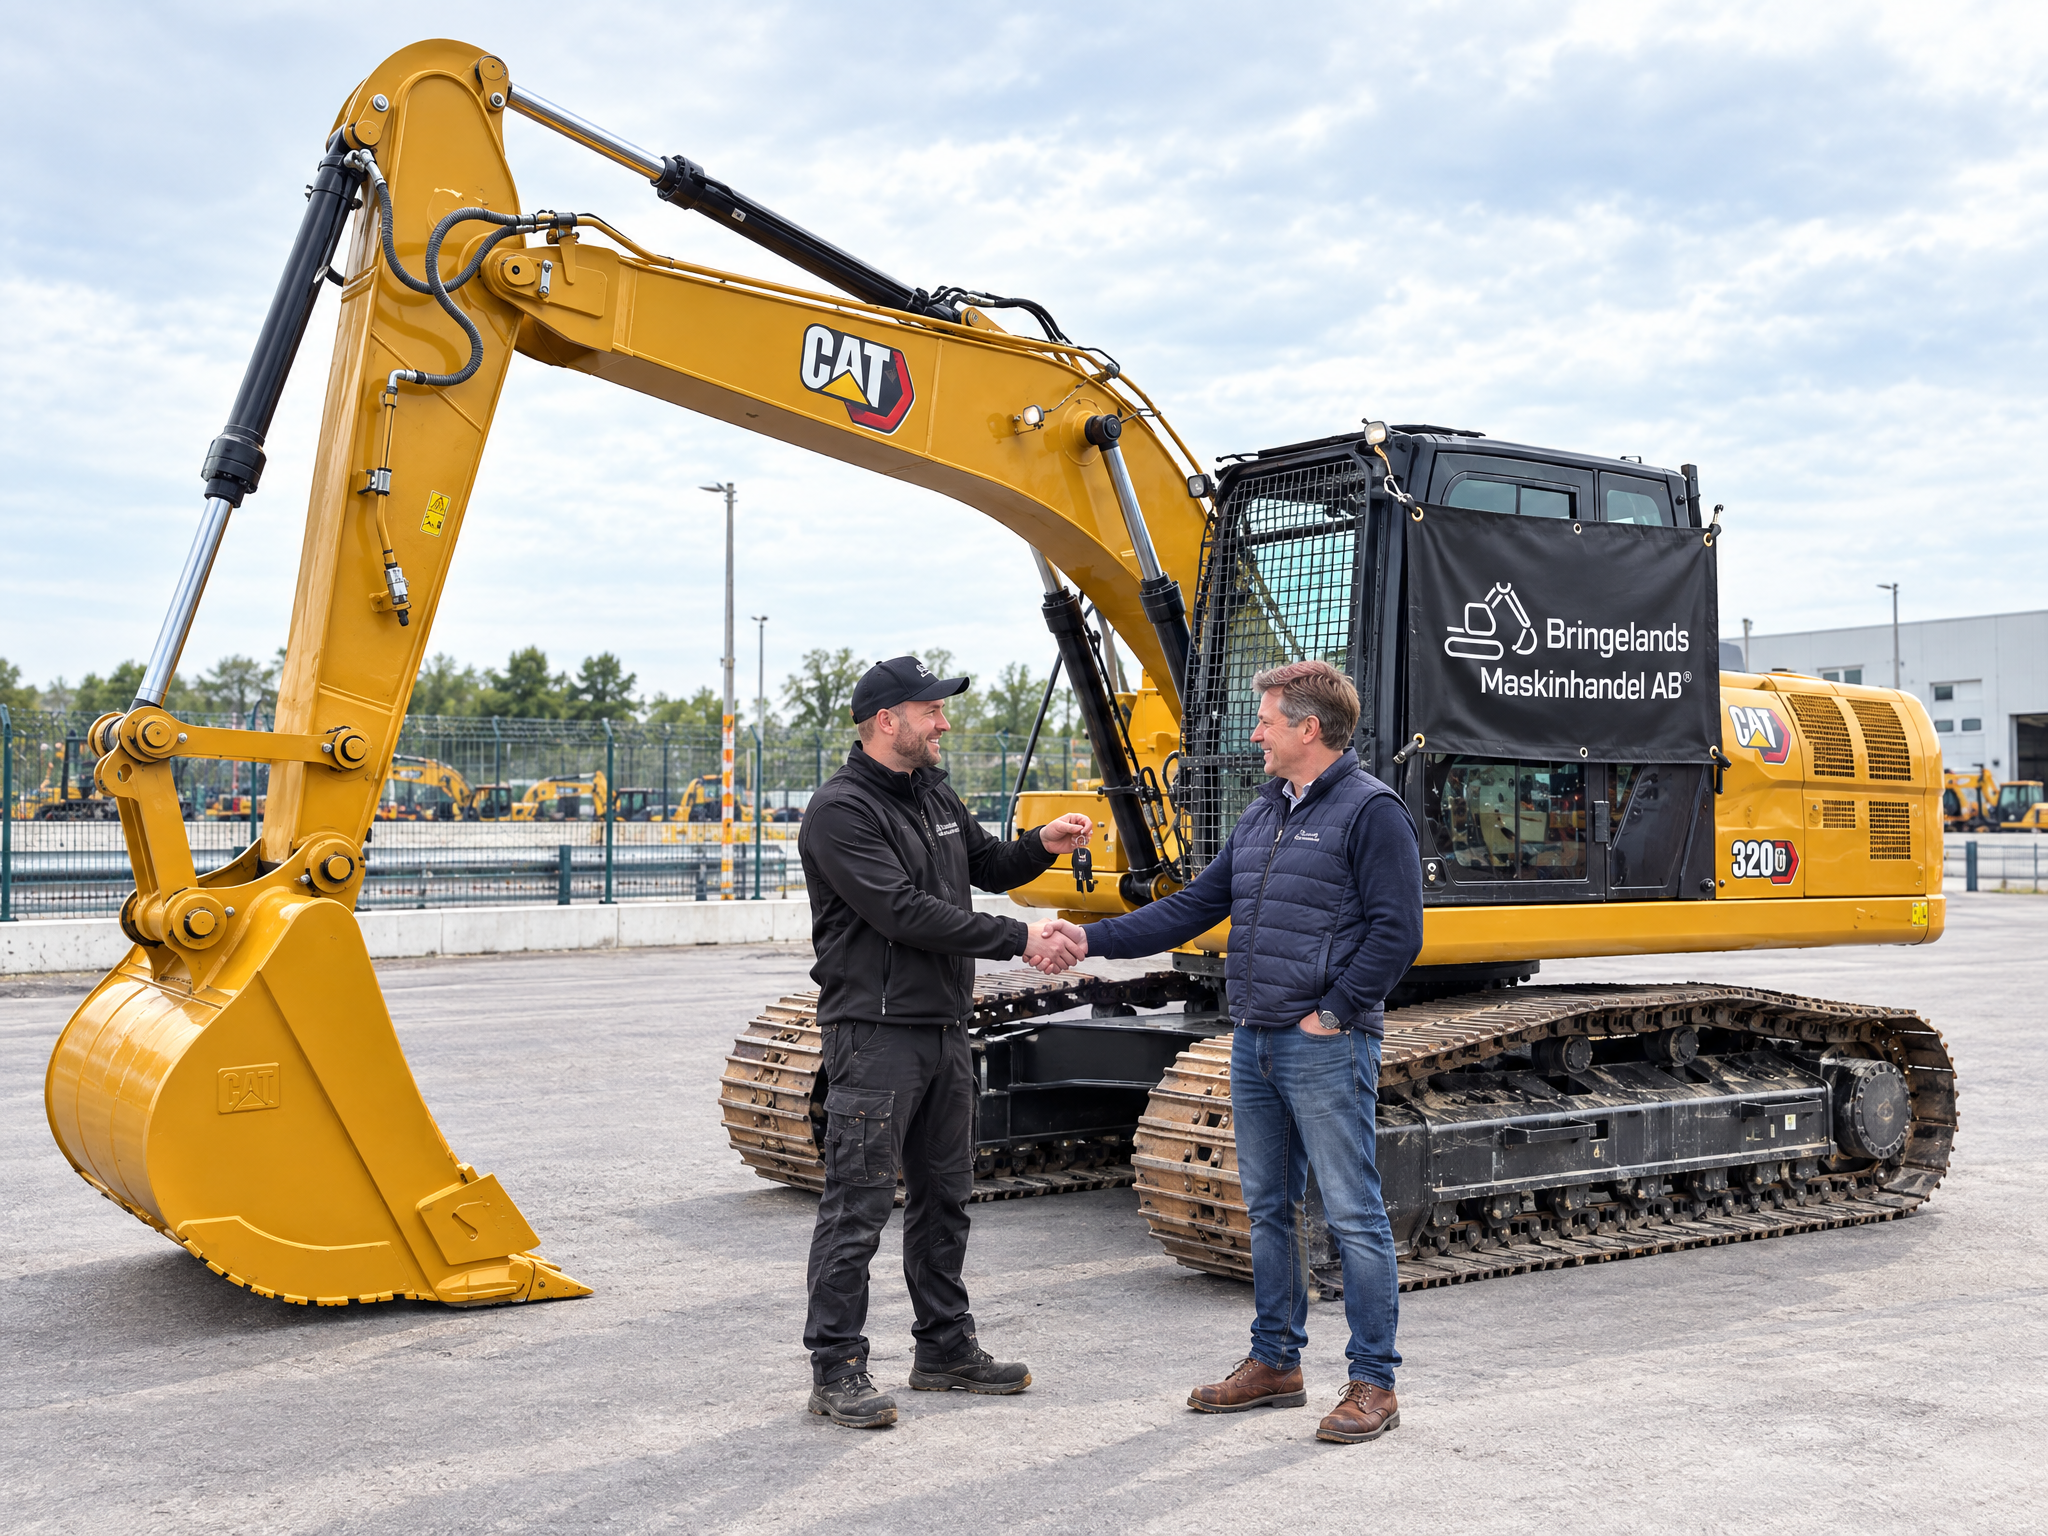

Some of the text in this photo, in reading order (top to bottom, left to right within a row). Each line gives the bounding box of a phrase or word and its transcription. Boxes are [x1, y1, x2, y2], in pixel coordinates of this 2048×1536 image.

[801, 325, 891, 408] CAT
[1546, 618, 1690, 659] Bringelands
[1480, 666, 1645, 700] Maskinhandel
[1729, 705, 1777, 748] CAT
[222, 1070, 274, 1107] CAT
